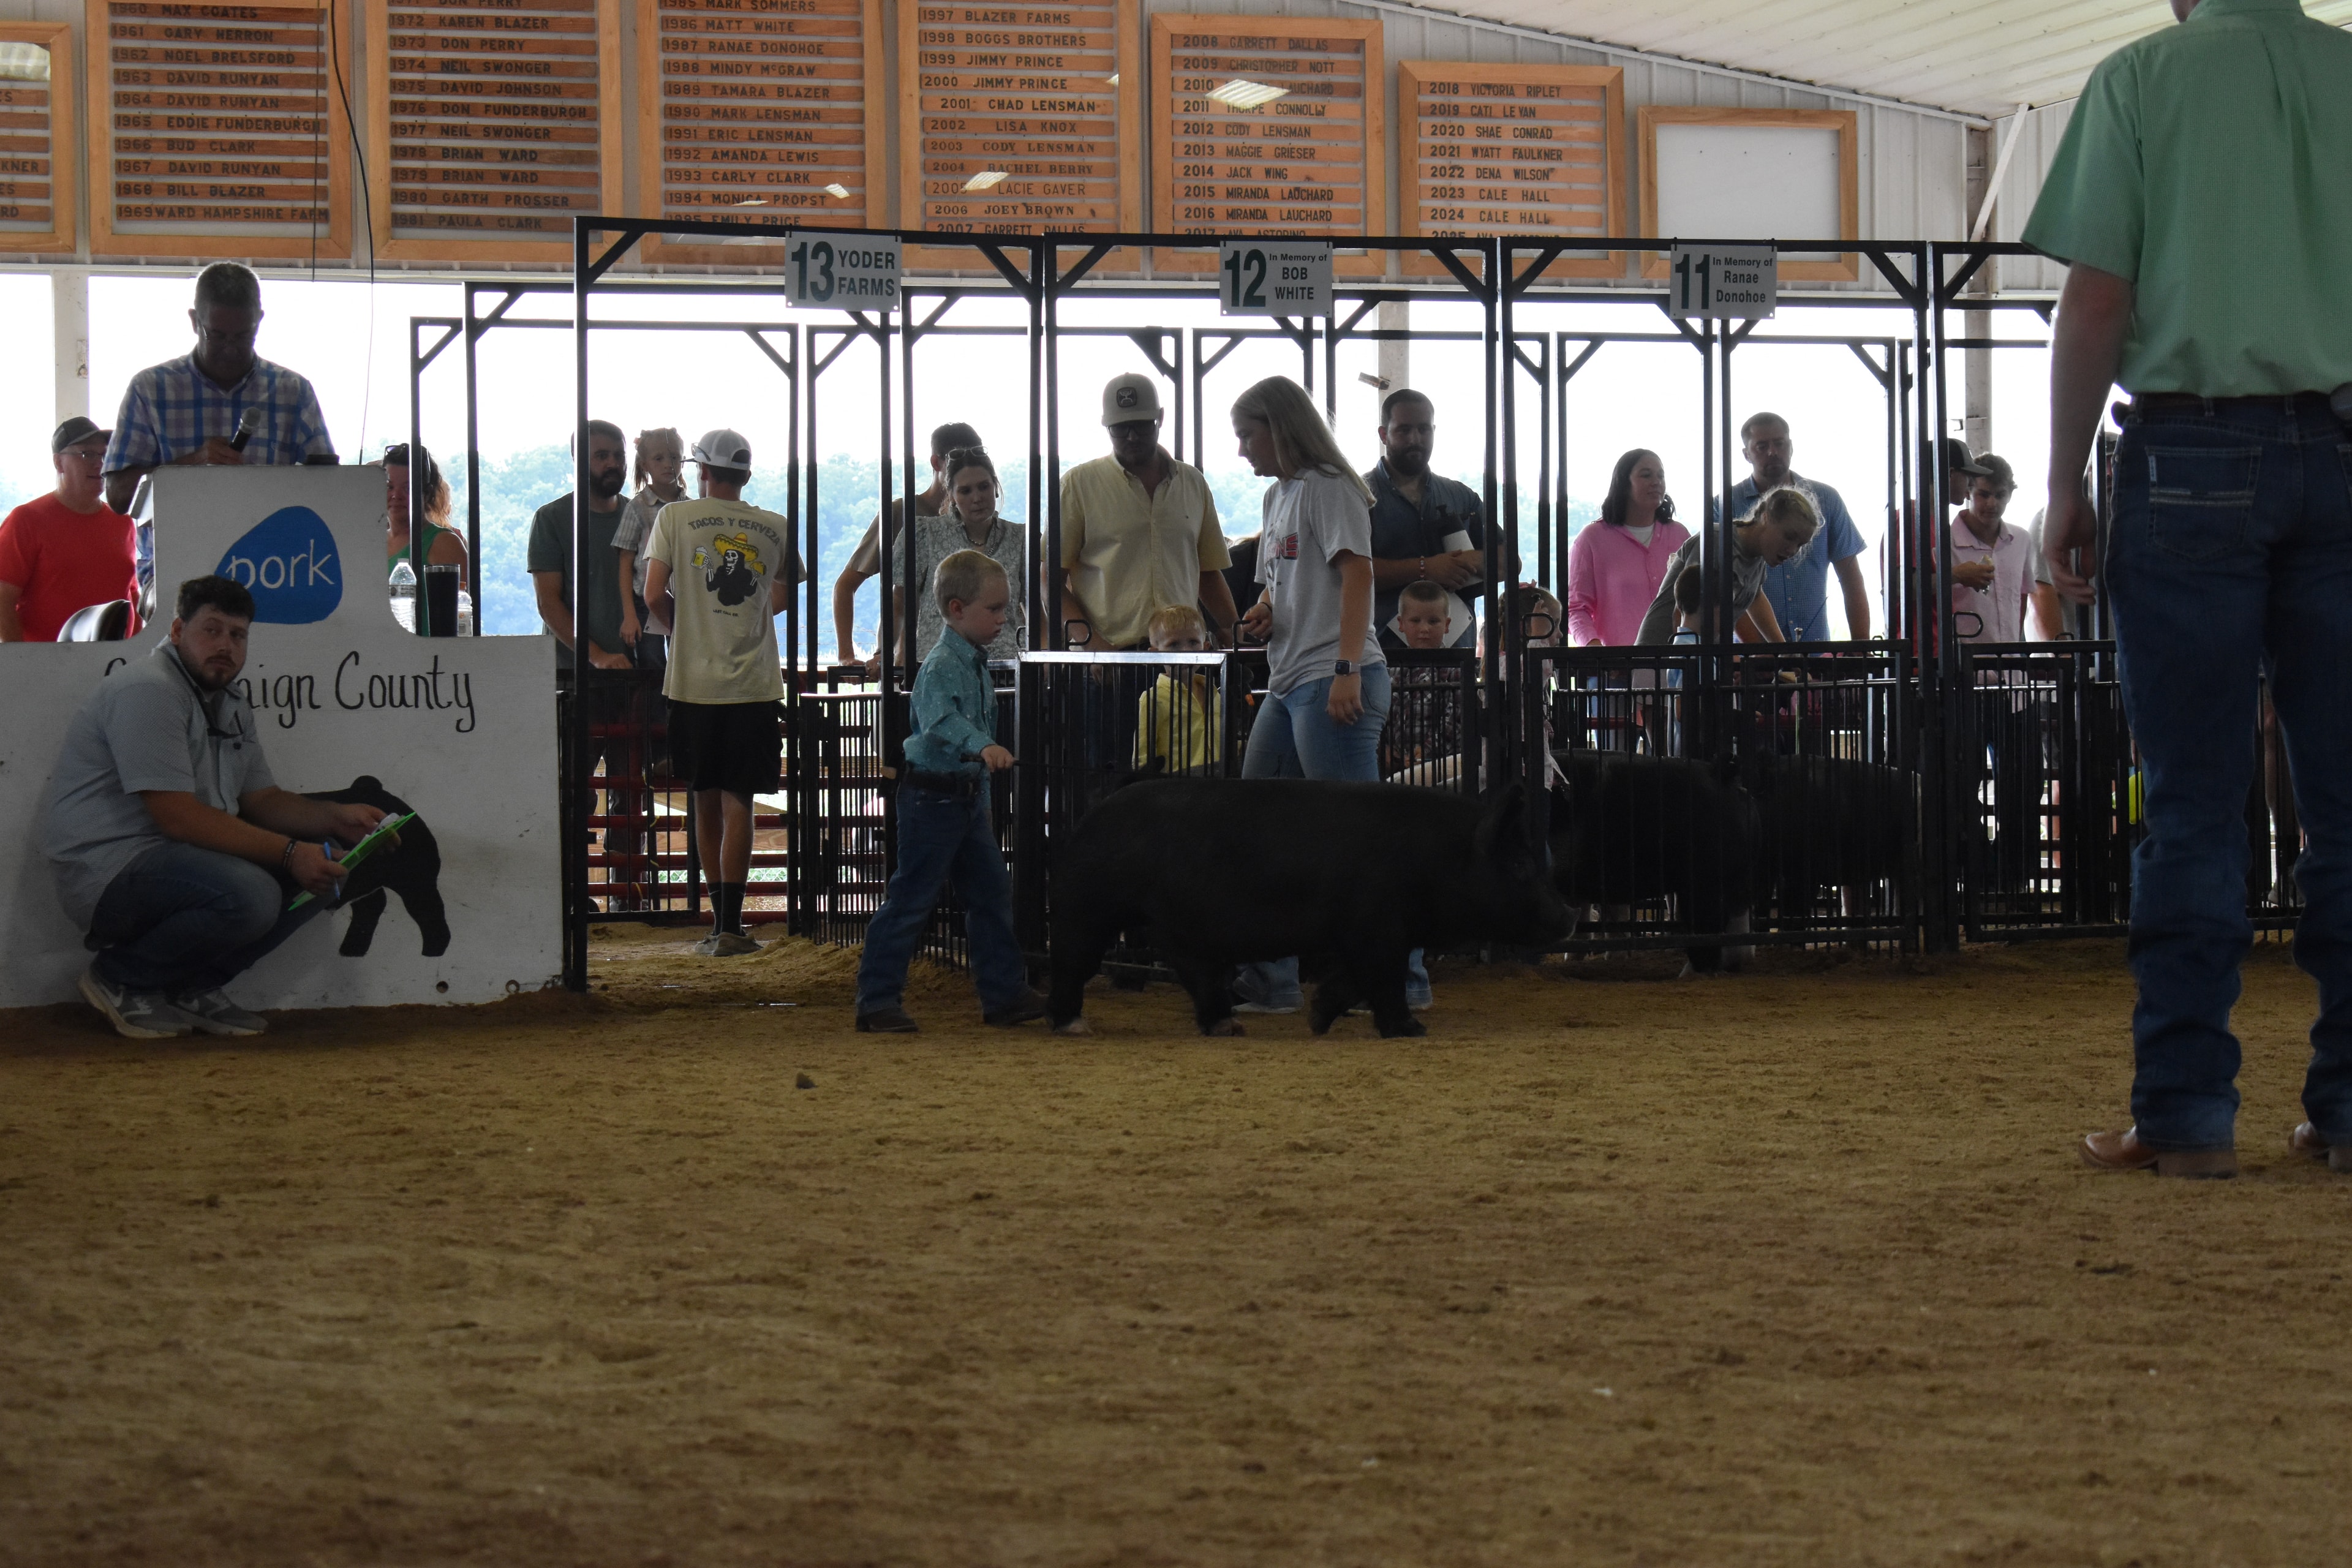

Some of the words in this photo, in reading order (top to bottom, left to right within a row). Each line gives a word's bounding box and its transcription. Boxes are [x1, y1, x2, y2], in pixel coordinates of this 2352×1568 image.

[391, 16, 424, 26] 1972
[439, 17, 484, 27] KAREN
[495, 18, 548, 29] BLAZER
[922, 10, 954, 21] 1997
[965, 12, 1016, 23] BLAZER
[1027, 13, 1071, 24] FARMS
[665, 20, 696, 29] 1986
[706, 20, 742, 31] MATT
[754, 22, 794, 32] WHITE
[393, 37, 426, 48] 1973
[442, 38, 469, 48] DON
[481, 39, 526, 51] PERRY
[924, 32, 954, 43] 1998
[966, 34, 1009, 44] BOGGS
[1019, 35, 1086, 46] BROTHERS
[1183, 36, 1218, 47] 2008
[1230, 37, 1276, 49] GARRETT
[1289, 39, 1328, 51] DALLAS
[665, 40, 698, 51] 1987
[709, 42, 753, 52] RANAE
[761, 43, 824, 55] DONOHOE
[393, 59, 426, 70] 1974
[441, 61, 471, 72] NEIL
[483, 62, 551, 74] SWONGER
[924, 54, 955, 64] 1999
[967, 55, 1006, 66] JIMMY
[1016, 56, 1063, 67] PRINCE
[1183, 58, 1218, 69] 2009
[1230, 59, 1298, 72] CHRISTOPHER
[1310, 62, 1334, 73] NOTT
[667, 62, 699, 72] 1988
[710, 64, 752, 74] MINDY
[925, 77, 957, 87] 2000
[973, 77, 1012, 88] JIMMY
[1020, 78, 1067, 89] PRINCE
[1184, 79, 1213, 91] 2010
[668, 84, 700, 95] 1989
[712, 86, 766, 97] TAMARA
[777, 86, 829, 98] BLAZER
[1430, 83, 1459, 95] 2018
[1471, 84, 1515, 97] VICTORIA
[1527, 86, 1561, 98] RIPLEY
[393, 102, 426, 113] 1976
[442, 104, 470, 114] DON
[485, 104, 586, 118] FUNDERBURGH
[941, 99, 970, 108] 2001
[989, 100, 1023, 110] CHAD
[1032, 100, 1095, 112] LENSMAN
[1184, 101, 1209, 112] 2011
[1431, 104, 1460, 115] 2019
[1471, 105, 1491, 116] CATI
[669, 107, 700, 117] 1990
[711, 108, 747, 118] MARK
[756, 109, 820, 120] LENSMAN
[394, 125, 426, 135] 1977
[441, 125, 471, 136] NEIL
[483, 127, 551, 138] SWONGER
[931, 120, 966, 130] 2002
[997, 121, 1027, 131] LISA
[1041, 122, 1076, 132] KNOX
[1184, 123, 1214, 135] 2012
[1226, 124, 1250, 135] CODY
[1262, 126, 1311, 137] LENSMAN
[1431, 125, 1464, 136] 2020
[1476, 127, 1501, 138] SHAE
[1513, 127, 1552, 140] CONRAD
[669, 128, 697, 138] 1991
[709, 129, 738, 140] ERIC
[748, 130, 813, 141] LENSMAN
[167, 141, 195, 150] BUD
[210, 141, 255, 152] CLARK
[931, 141, 962, 151] 2003
[983, 142, 1016, 151] CODY
[1028, 143, 1095, 153] LENSMAN
[1184, 144, 1215, 156] 2013
[1226, 146, 1262, 158] MAGGIE
[1275, 147, 1315, 159] GRIESER
[1431, 146, 1460, 157] 2021
[1472, 147, 1501, 159] WYATT
[1513, 148, 1562, 160] FAULKNER
[668, 149, 700, 160] 1992
[711, 150, 767, 161] AMANDA
[778, 151, 819, 162] LEWIS
[169, 162, 211, 173] DAVID
[222, 163, 281, 175] RUNYAN
[933, 162, 965, 172] 2004
[988, 163, 1042, 173] RACHEL
[1050, 165, 1093, 174] BERRY
[1184, 165, 1214, 176] 2014
[1227, 167, 1252, 178] JACK
[1265, 168, 1287, 179] WING
[1431, 166, 1464, 178] 2022
[1476, 168, 1501, 179] DENA
[1513, 169, 1549, 180] WILSON
[394, 170, 427, 181] 1979
[442, 170, 484, 181] BRIAN
[500, 172, 538, 183] WARD
[668, 170, 701, 181] 1993
[712, 172, 756, 183] CARLY
[767, 173, 810, 184] CLARK
[998, 184, 1033, 194] LACIE
[1044, 184, 1085, 195] GAVER
[1184, 186, 1215, 197] 2015
[1226, 187, 1269, 199] MIRANDA
[1281, 189, 1333, 201] LAUCHARD
[1431, 187, 1464, 198] 2023
[1479, 189, 1507, 200] CALE
[1522, 190, 1550, 202] HALL
[394, 192, 427, 202] 1980
[443, 193, 488, 204] GARTH
[505, 194, 569, 206] PROSSER
[669, 192, 701, 203] 1994
[774, 194, 826, 205] PROPST
[935, 205, 968, 214] 2006
[985, 206, 1018, 214] JOEY
[1025, 206, 1074, 215] BROWN
[1185, 208, 1215, 219] 2016
[1226, 209, 1268, 220] MIRANDA
[1280, 210, 1332, 222] LAUCHARD
[1431, 209, 1464, 220] 2024
[1480, 211, 1508, 222] CALE
[1520, 212, 1549, 224] HALL
[838, 250, 895, 269] YODER
[1281, 254, 1315, 263] Memory
[1725, 258, 1760, 268] Memory
[791, 241, 834, 301] 13
[1225, 249, 1266, 306] 12
[1283, 267, 1308, 280] BOB
[1724, 271, 1758, 283] Ranae
[838, 277, 894, 296] FARMS
[1675, 254, 1710, 309] 11
[1275, 287, 1314, 300] WHITE
[1716, 290, 1766, 303] Donohoe
[688, 518, 724, 530] TACOS
[728, 518, 734, 526] Y
[739, 519, 781, 546] CERVEZA
[226, 539, 335, 589] pork
[335, 650, 476, 733] County
